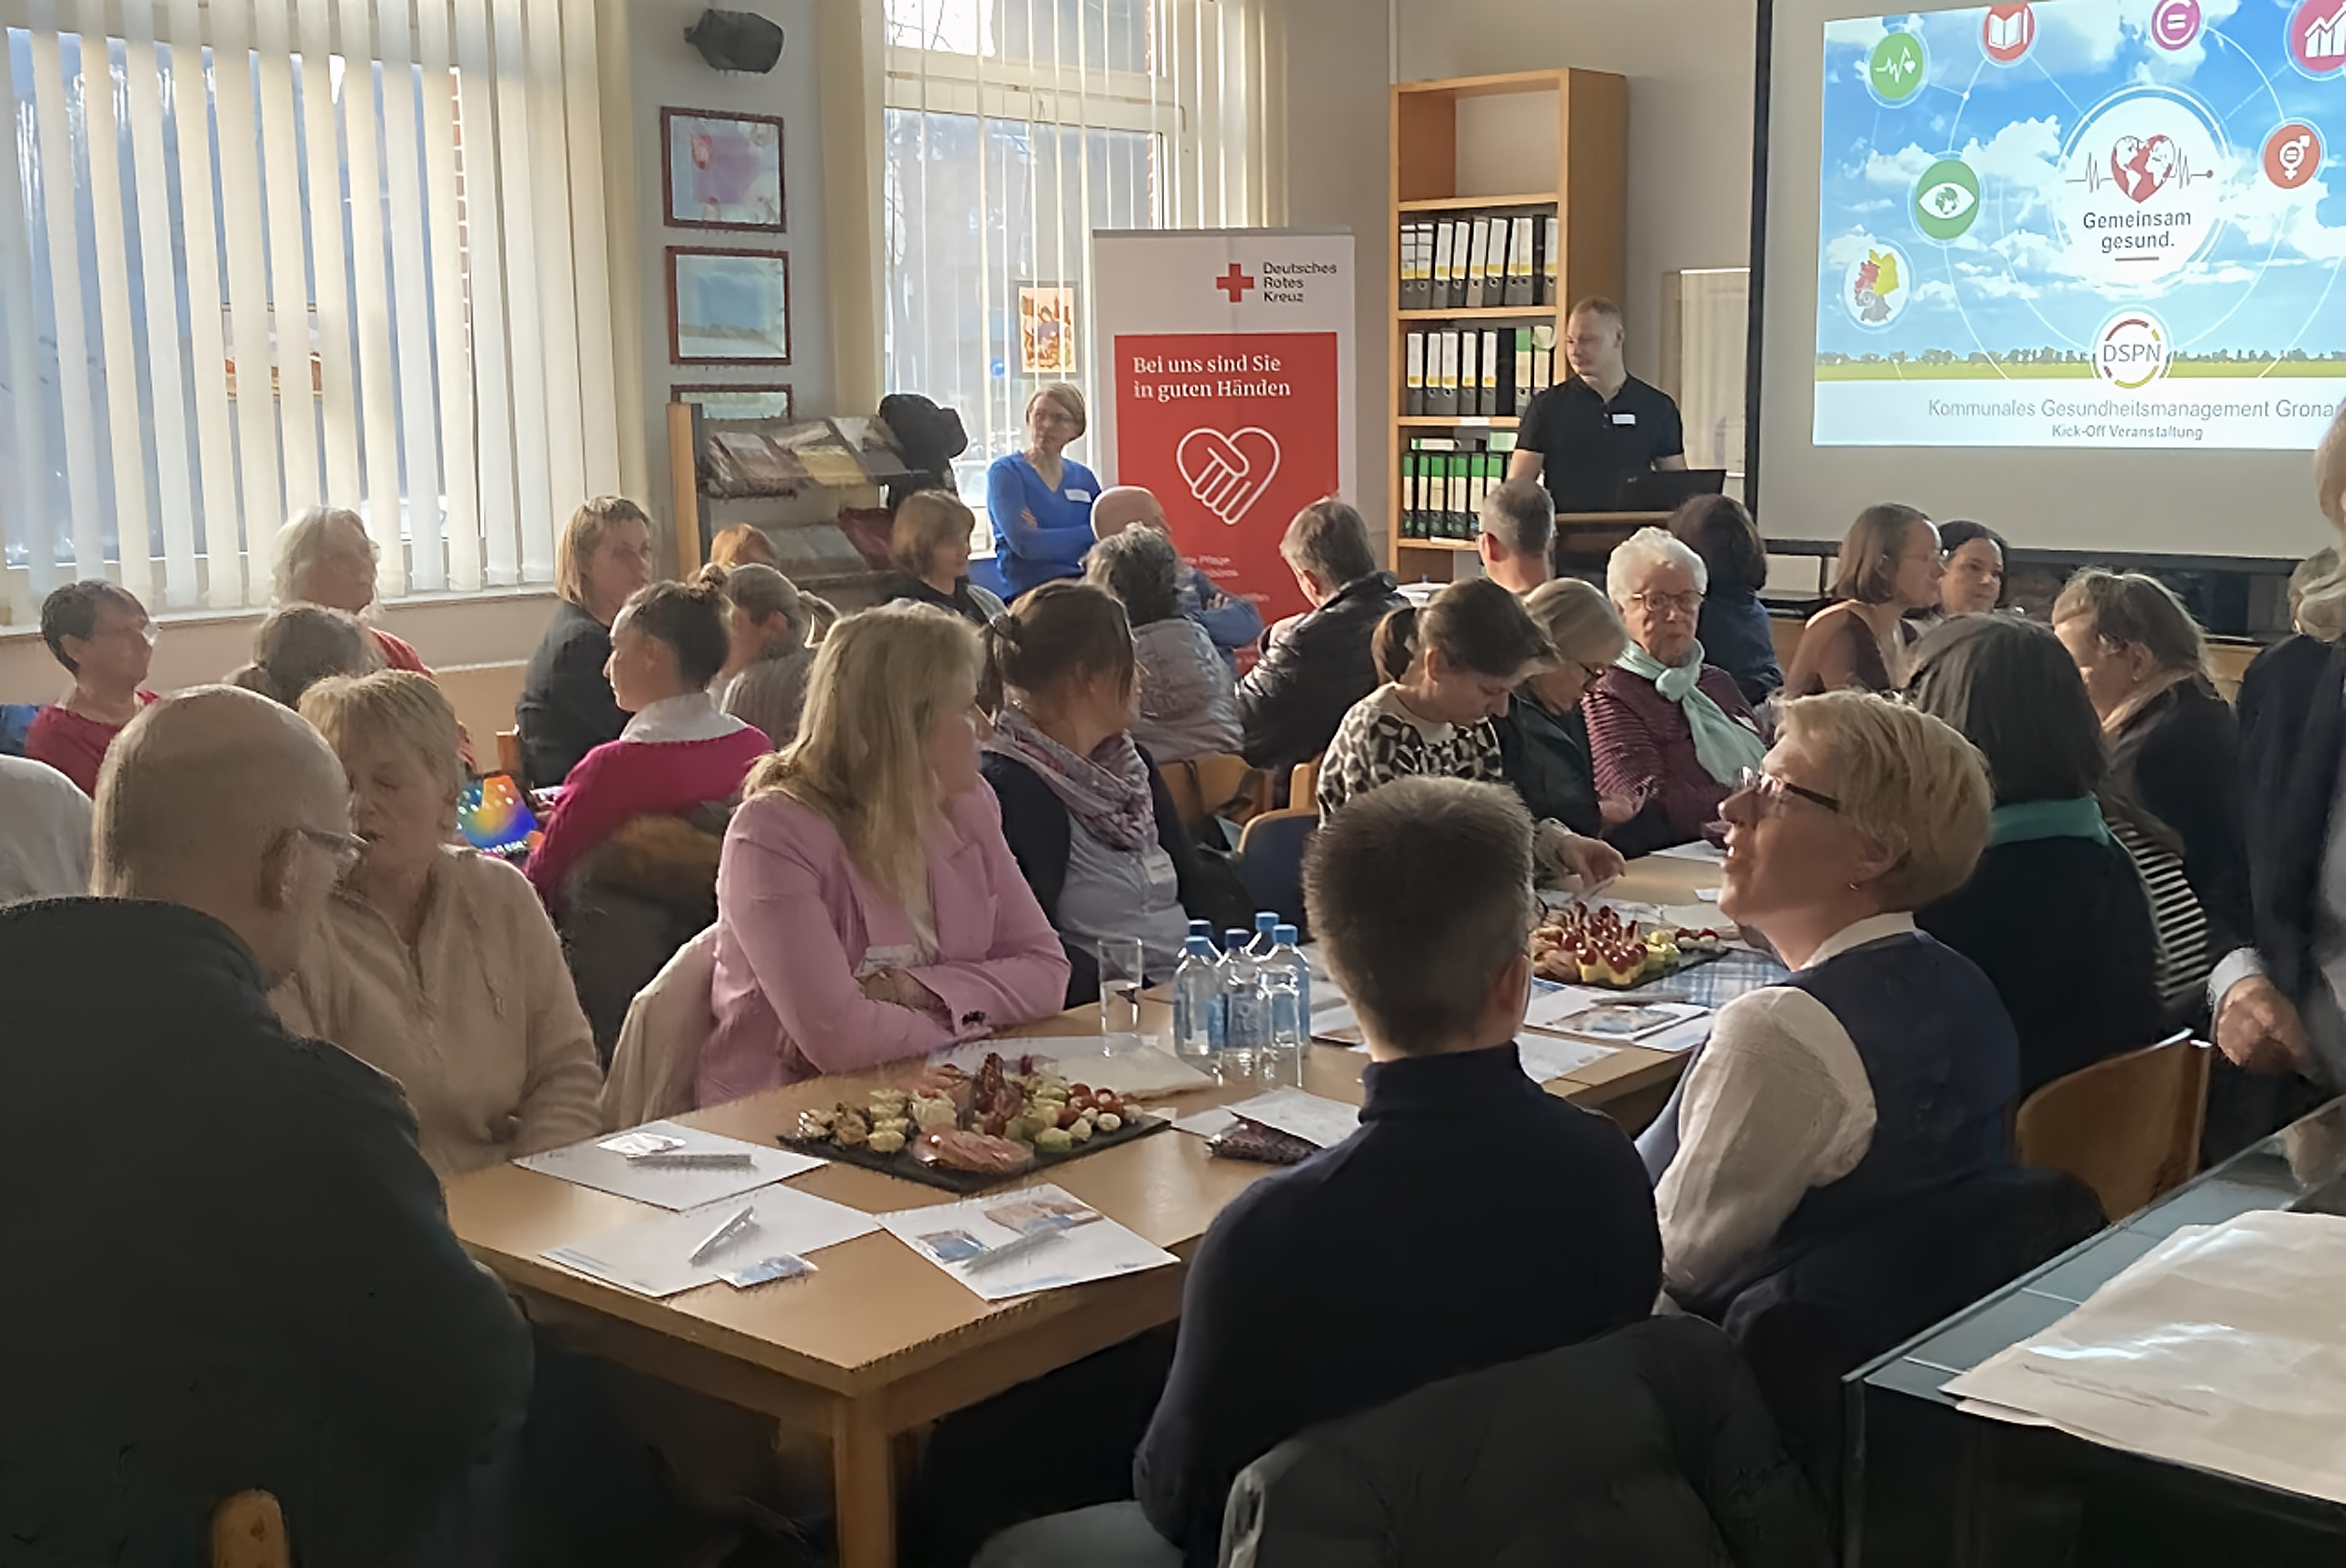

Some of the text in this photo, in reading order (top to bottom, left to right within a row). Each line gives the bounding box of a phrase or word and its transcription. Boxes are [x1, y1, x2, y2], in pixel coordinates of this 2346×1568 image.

[2083, 210, 2191, 228] Gemeinsam
[2101, 231, 2174, 253] gesund.
[1263, 261, 1336, 274] Deutsches
[1263, 277, 1304, 289] Rotes
[1263, 291, 1304, 303] Kreuz
[2103, 344, 2161, 362] DSPN
[1133, 355, 1280, 373] Bei uns sind Sie
[1134, 380, 1291, 402] in guten Händen
[1929, 399, 2341, 420] Kommunales Gesundheitsmanagement Grona
[2052, 424, 2203, 440] Kick-Off Veranstaltung
